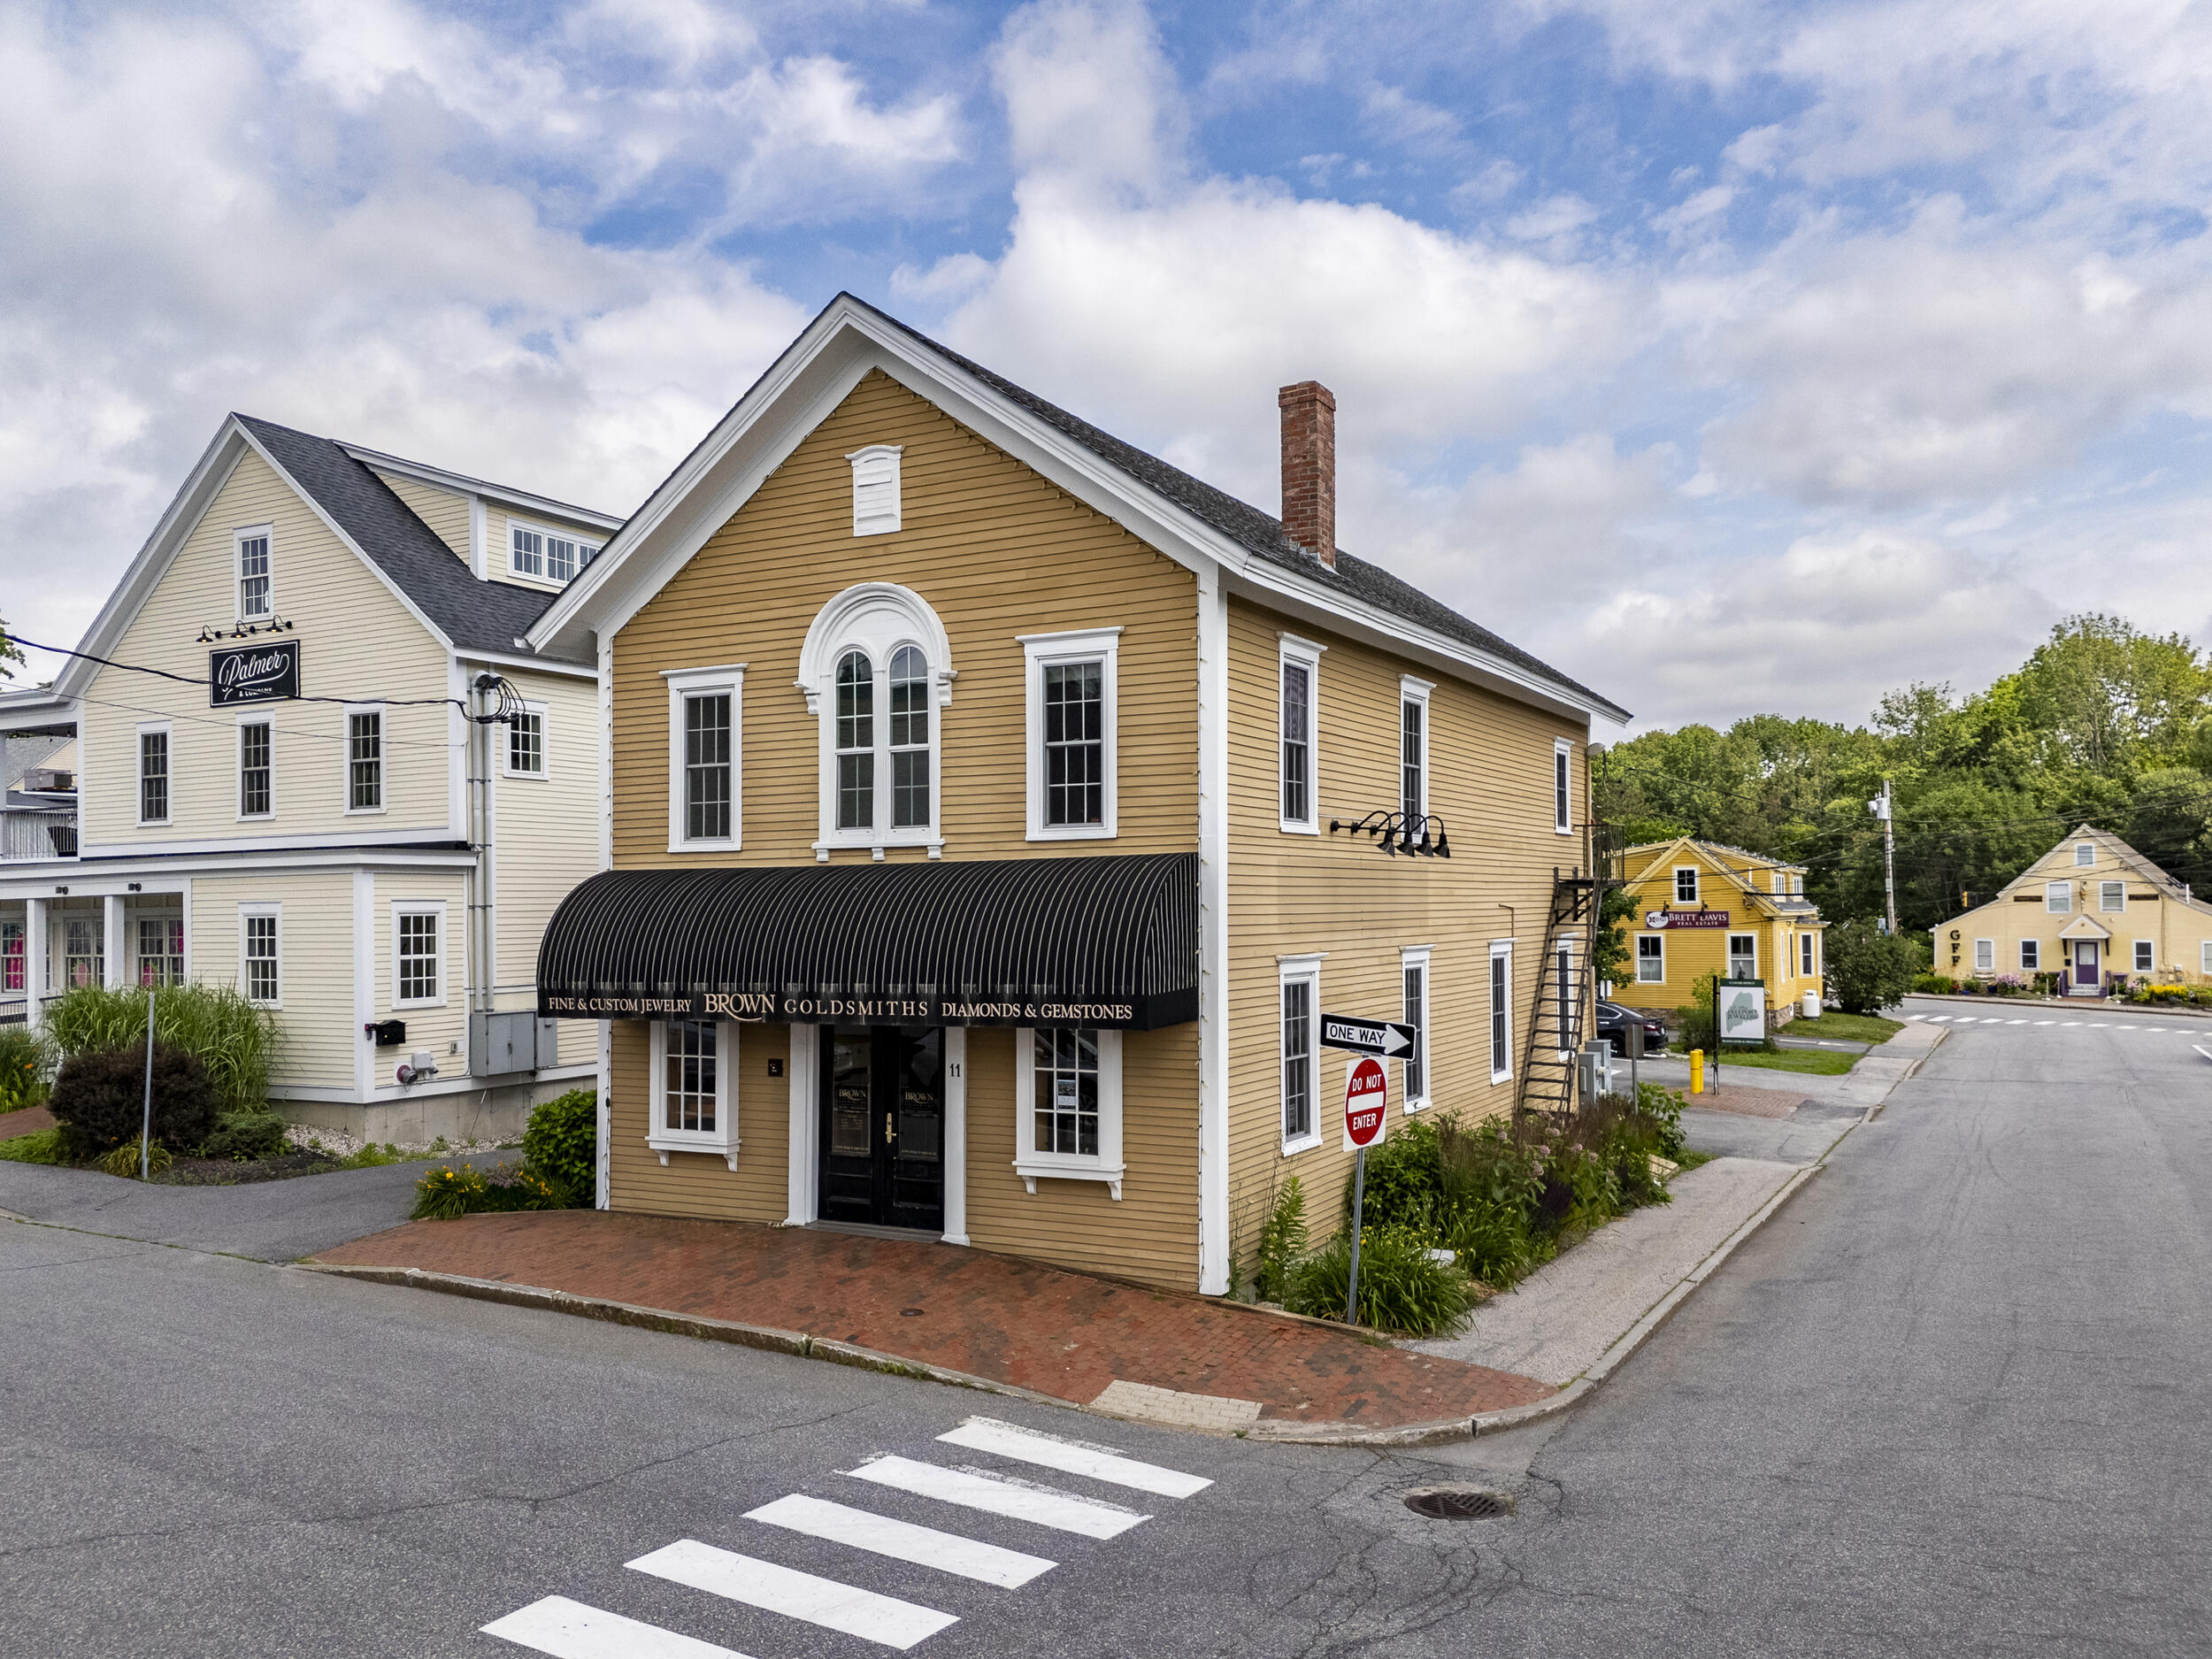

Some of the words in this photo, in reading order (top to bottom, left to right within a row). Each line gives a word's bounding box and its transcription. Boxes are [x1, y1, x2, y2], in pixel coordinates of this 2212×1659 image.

[219, 650, 290, 701] Palmer
[1669, 912, 1697, 921] BRETT
[549, 997, 575, 1010] FINE
[577, 998, 588, 1010] &
[588, 998, 638, 1012] CUSTOM
[640, 999, 692, 1014] JEWELRY
[703, 993, 775, 1021] BROWN
[784, 999, 928, 1016] GOLDSMITHS
[941, 1002, 1021, 1018] DIAMONDS
[1025, 1003, 1037, 1018] &
[1041, 1003, 1133, 1019] GEMSTONES
[1330, 1025, 1355, 1041] ONE
[1359, 1029, 1386, 1045] WAY
[949, 1063, 961, 1078] 11
[1352, 1079, 1363, 1092] DO
[1365, 1073, 1382, 1089] NOT
[839, 1088, 866, 1101] BROWN
[905, 1092, 933, 1104] BROWN
[1353, 1112, 1377, 1132] ENTER
